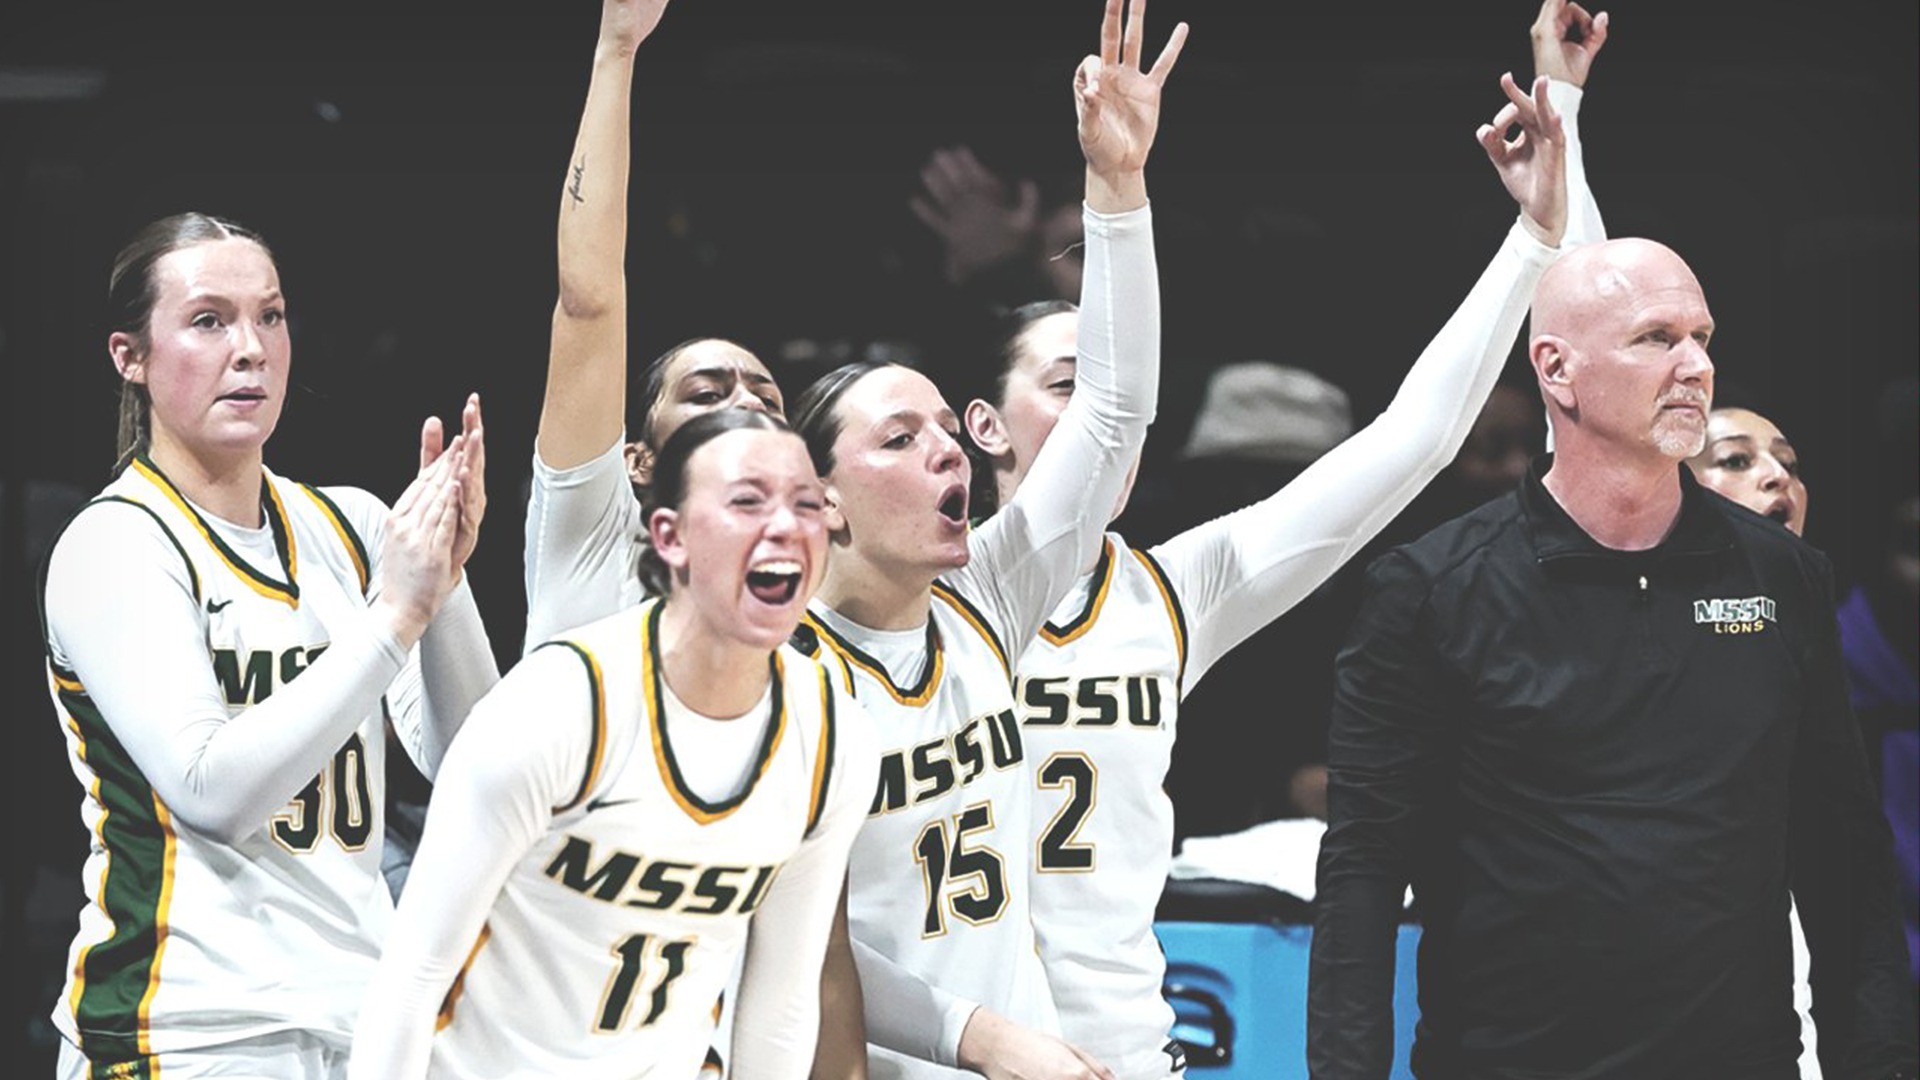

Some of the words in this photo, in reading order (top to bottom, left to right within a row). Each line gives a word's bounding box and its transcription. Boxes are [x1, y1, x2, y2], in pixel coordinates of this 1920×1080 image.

[1693, 595, 1777, 623] MSSU
[1714, 619, 1764, 634] LIONS
[1012, 674, 1162, 730] SSU
[1036, 751, 1098, 874] 2
[912, 799, 1011, 939] 15
[590, 931, 699, 1034] 11
